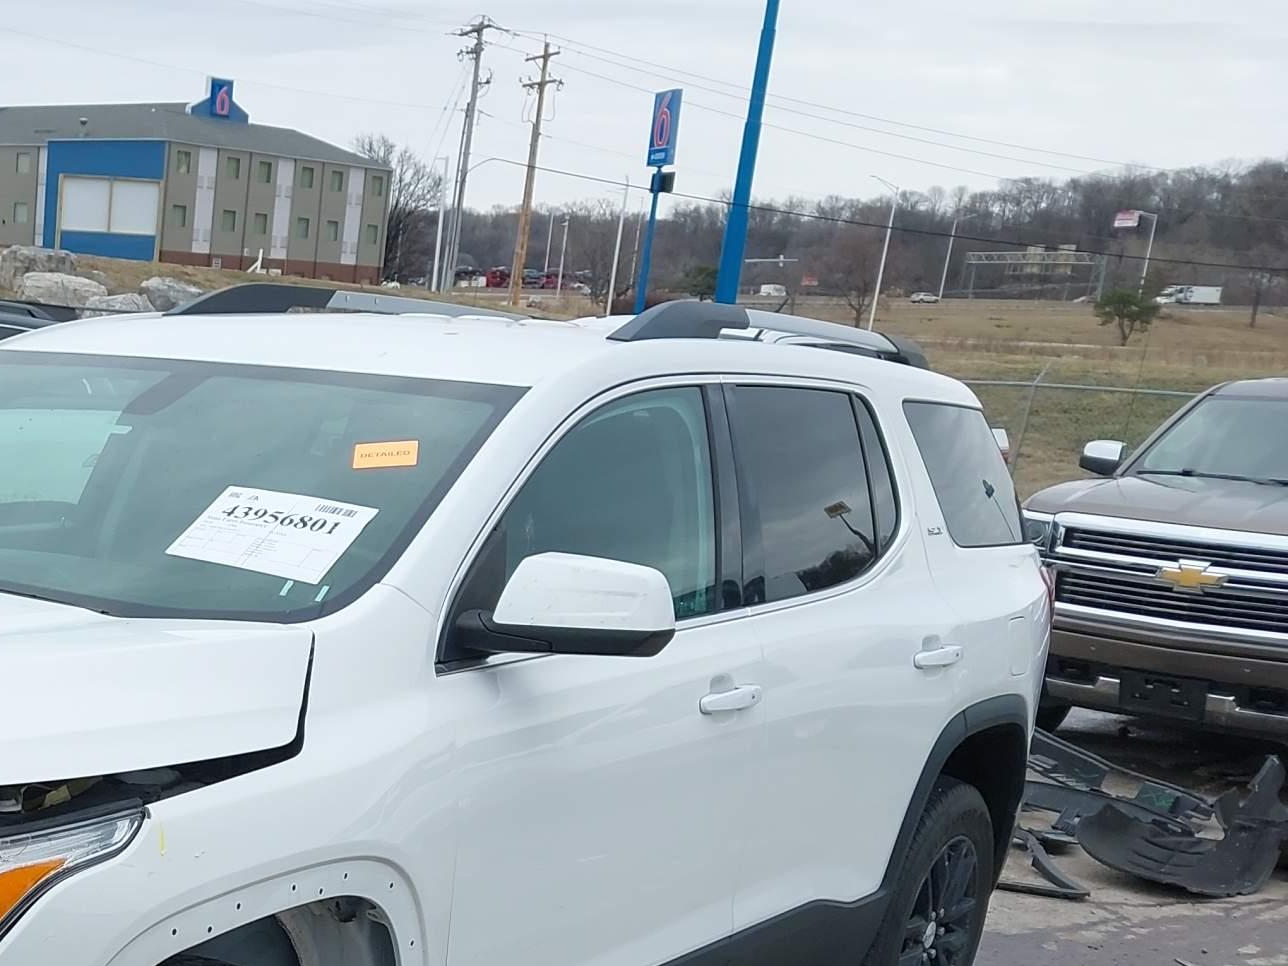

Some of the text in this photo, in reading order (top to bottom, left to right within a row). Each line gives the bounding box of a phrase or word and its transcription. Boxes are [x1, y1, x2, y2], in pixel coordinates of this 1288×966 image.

[216, 86, 229, 115] 6
[654, 93, 672, 147] 6
[222, 504, 340, 535] 43956801
